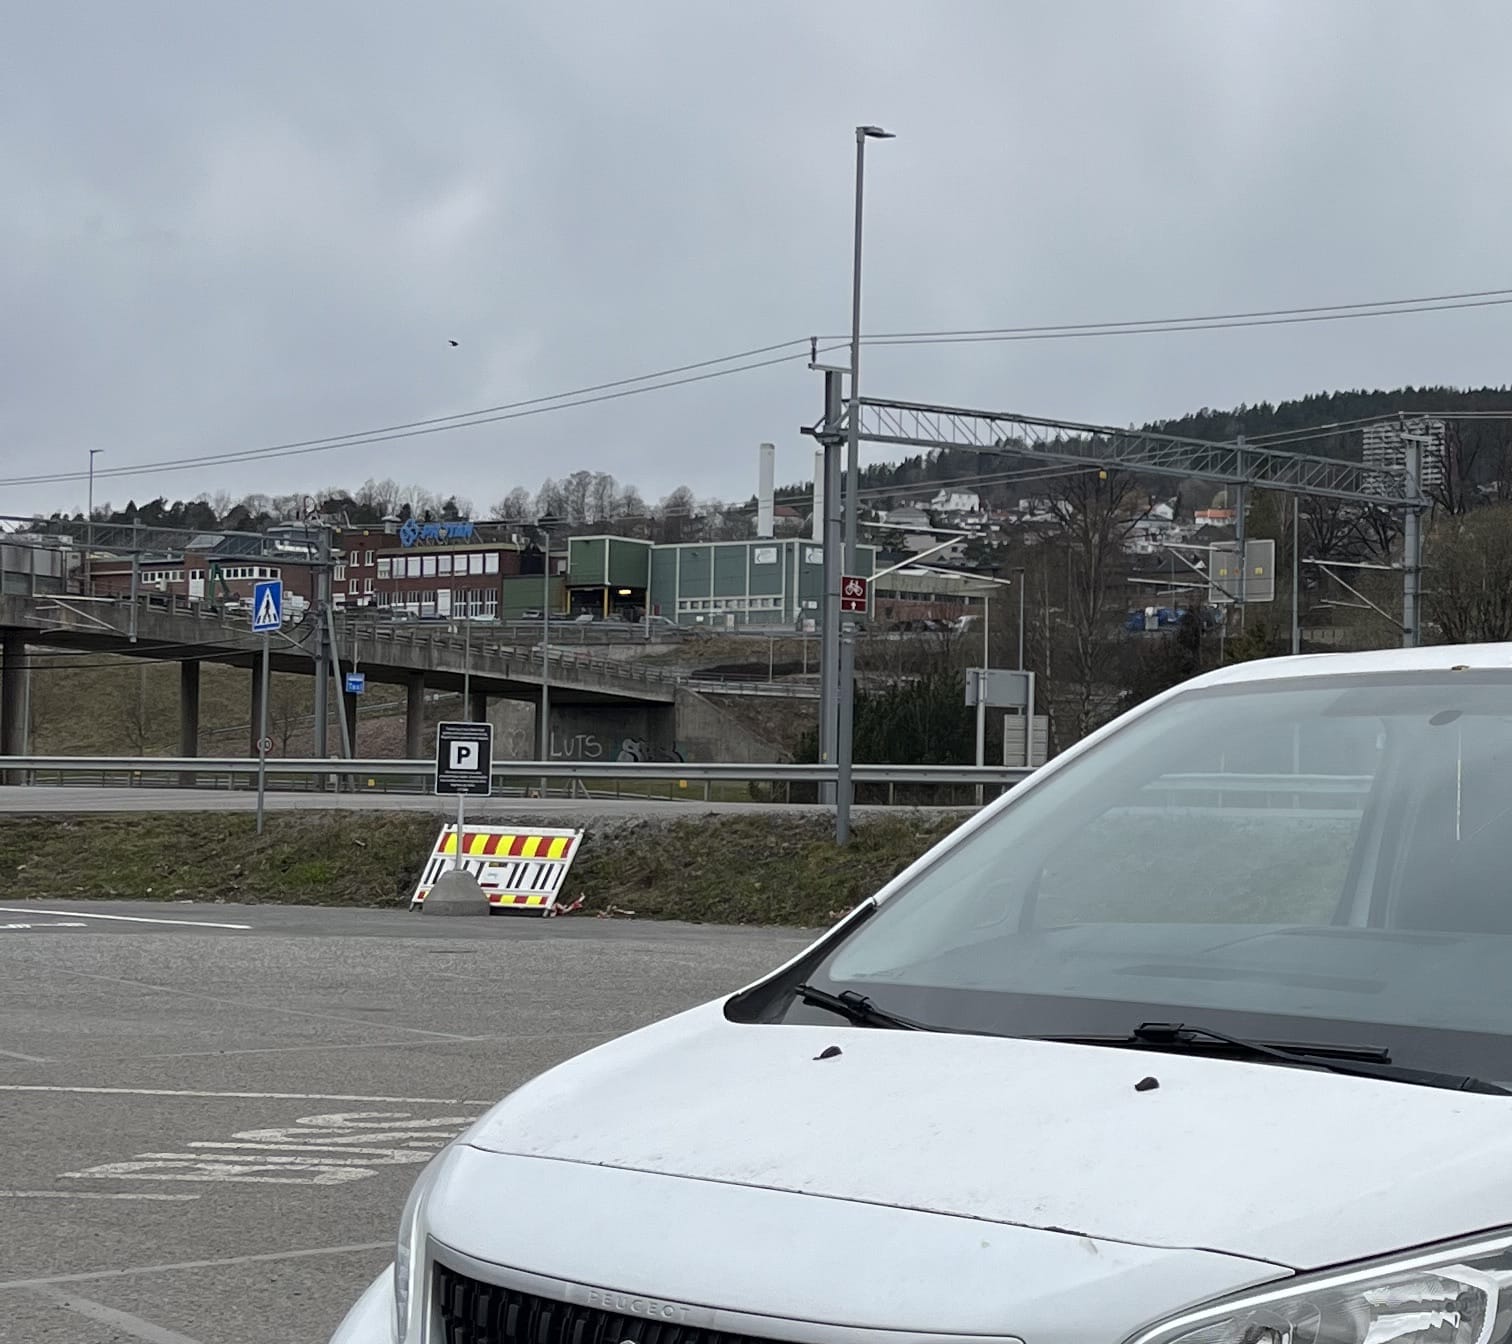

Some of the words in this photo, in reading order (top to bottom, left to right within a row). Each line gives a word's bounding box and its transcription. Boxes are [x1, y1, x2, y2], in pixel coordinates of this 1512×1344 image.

[457, 746, 471, 764] P
[551, 732, 602, 758] LUTS
[587, 1290, 690, 1321] PEUGEOT
